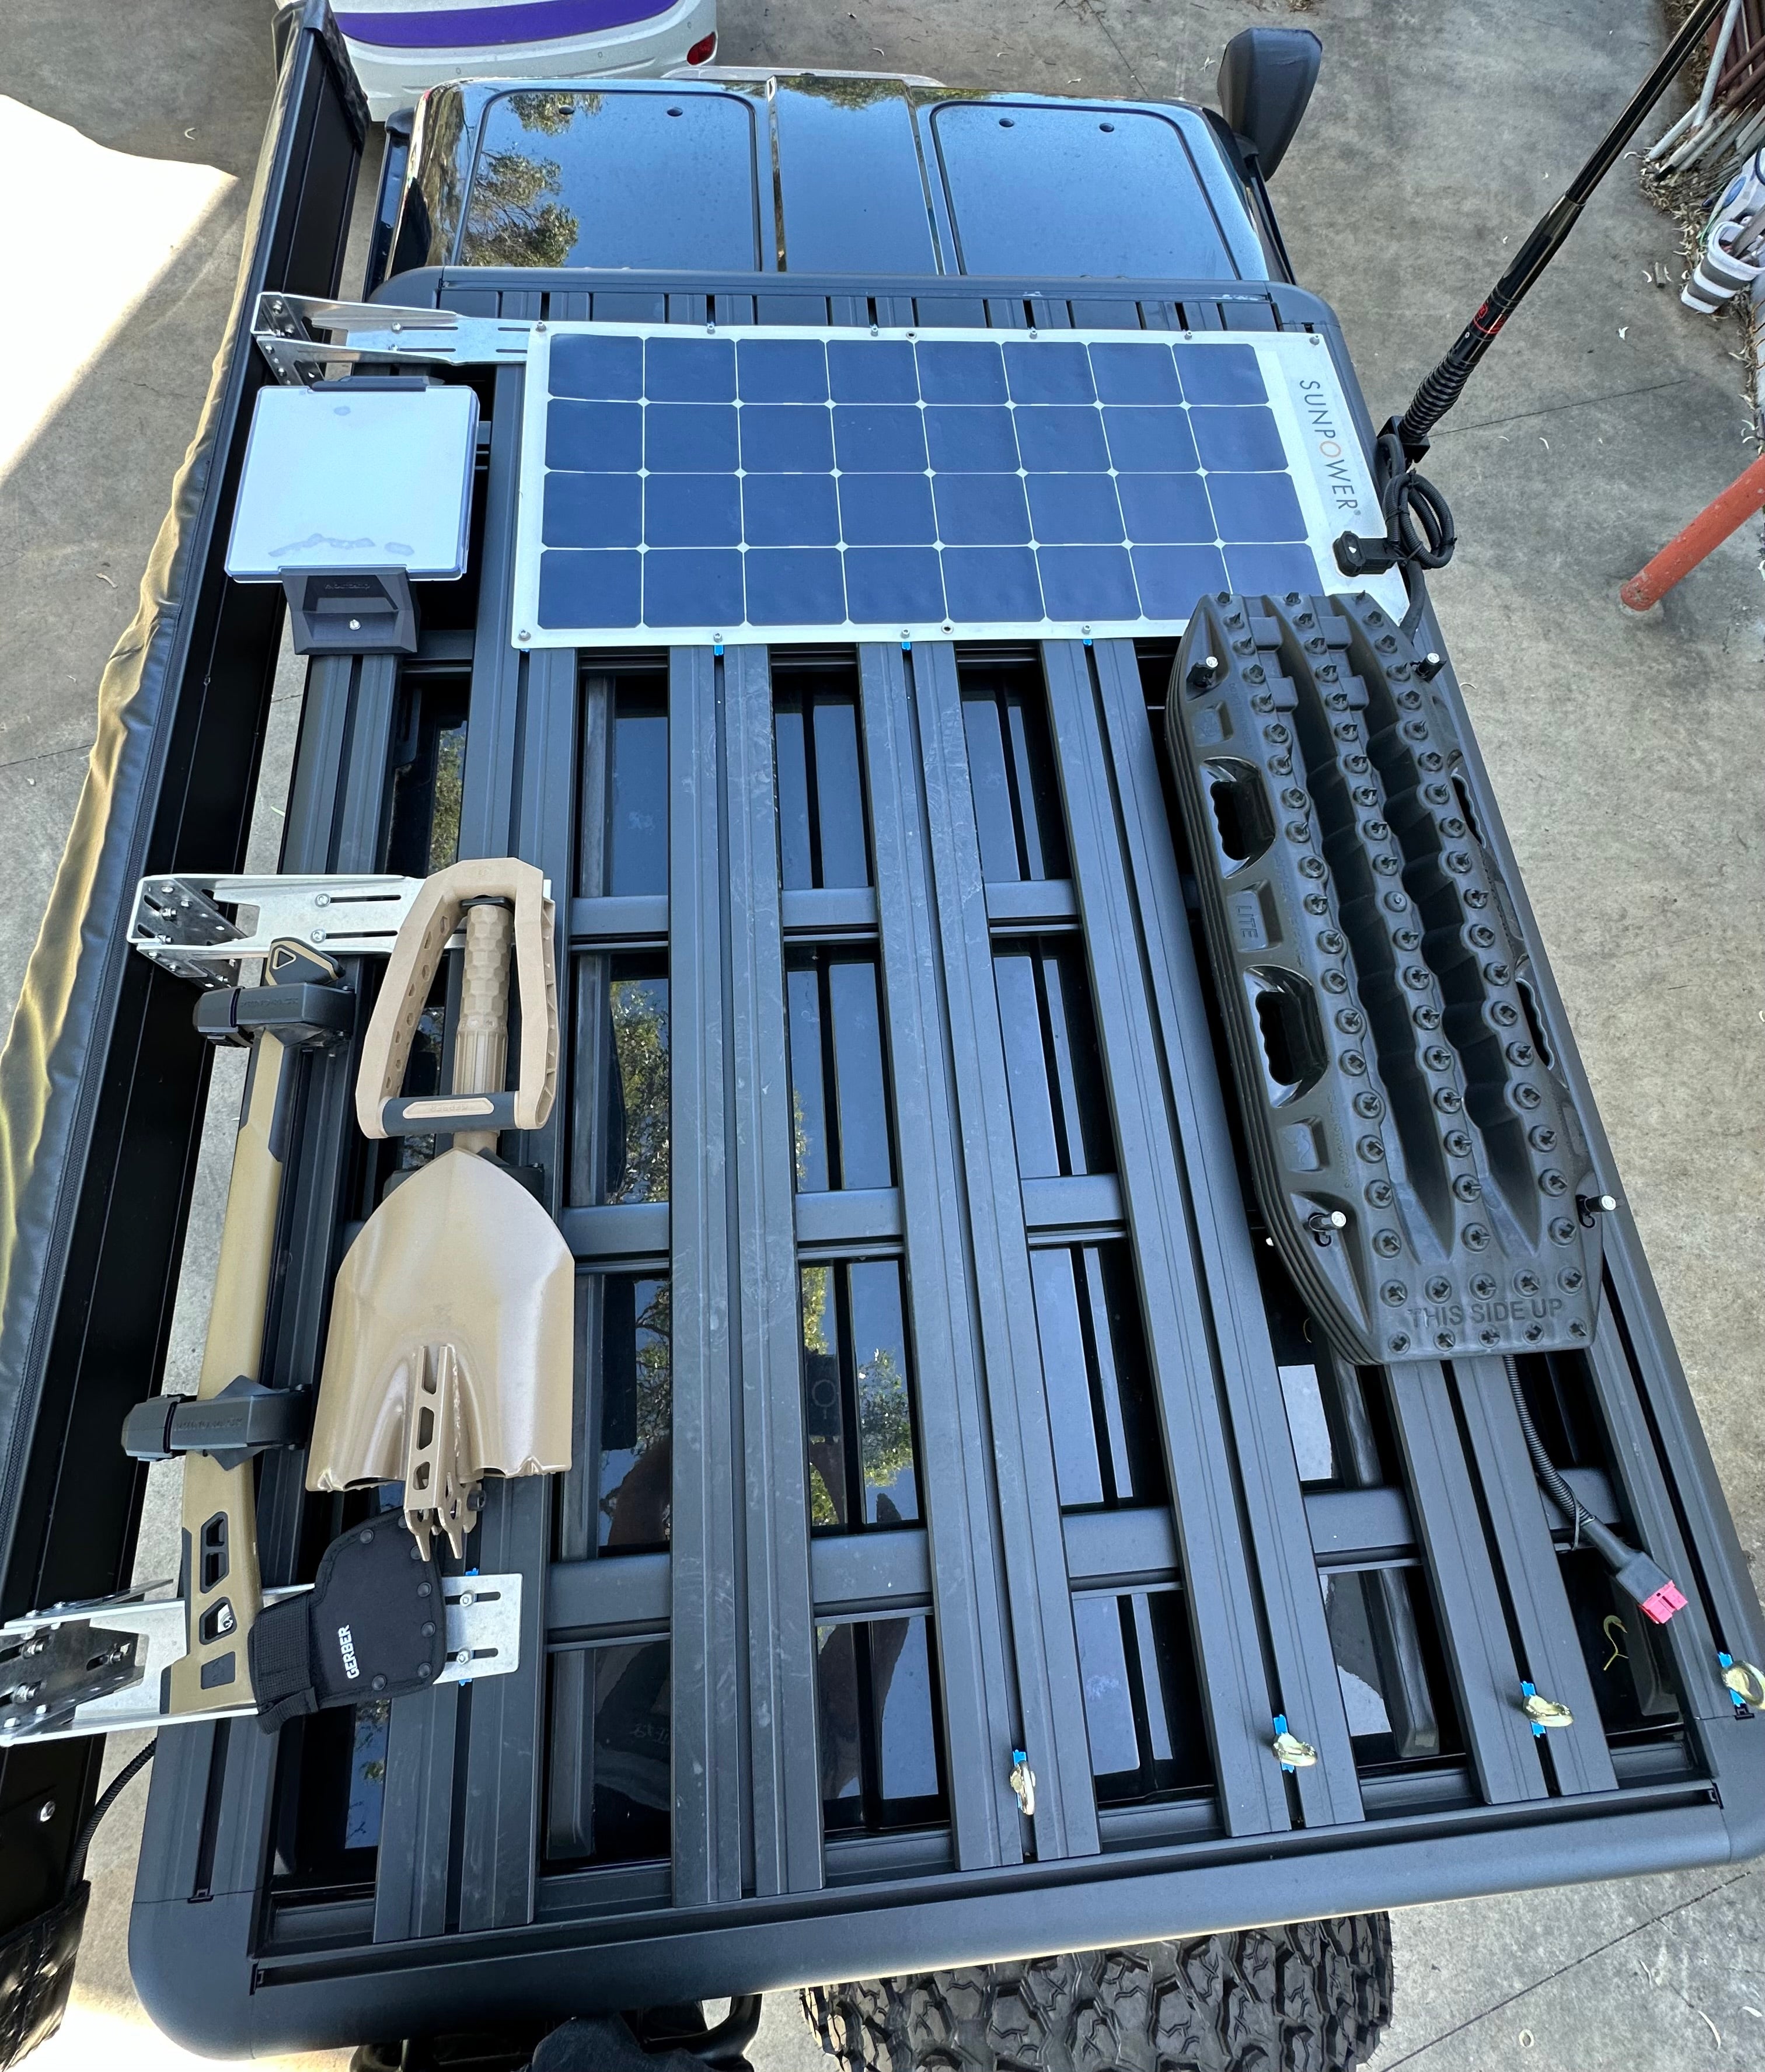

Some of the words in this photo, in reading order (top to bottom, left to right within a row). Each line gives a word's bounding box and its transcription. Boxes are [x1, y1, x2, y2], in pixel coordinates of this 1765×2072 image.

[1236, 905, 1258, 938] LITE
[1407, 1305, 1464, 1328] THIS
[1471, 1301, 1526, 1324] SIDE
[1532, 1297, 1563, 1318] UP
[338, 1624, 360, 1679] GERBER
